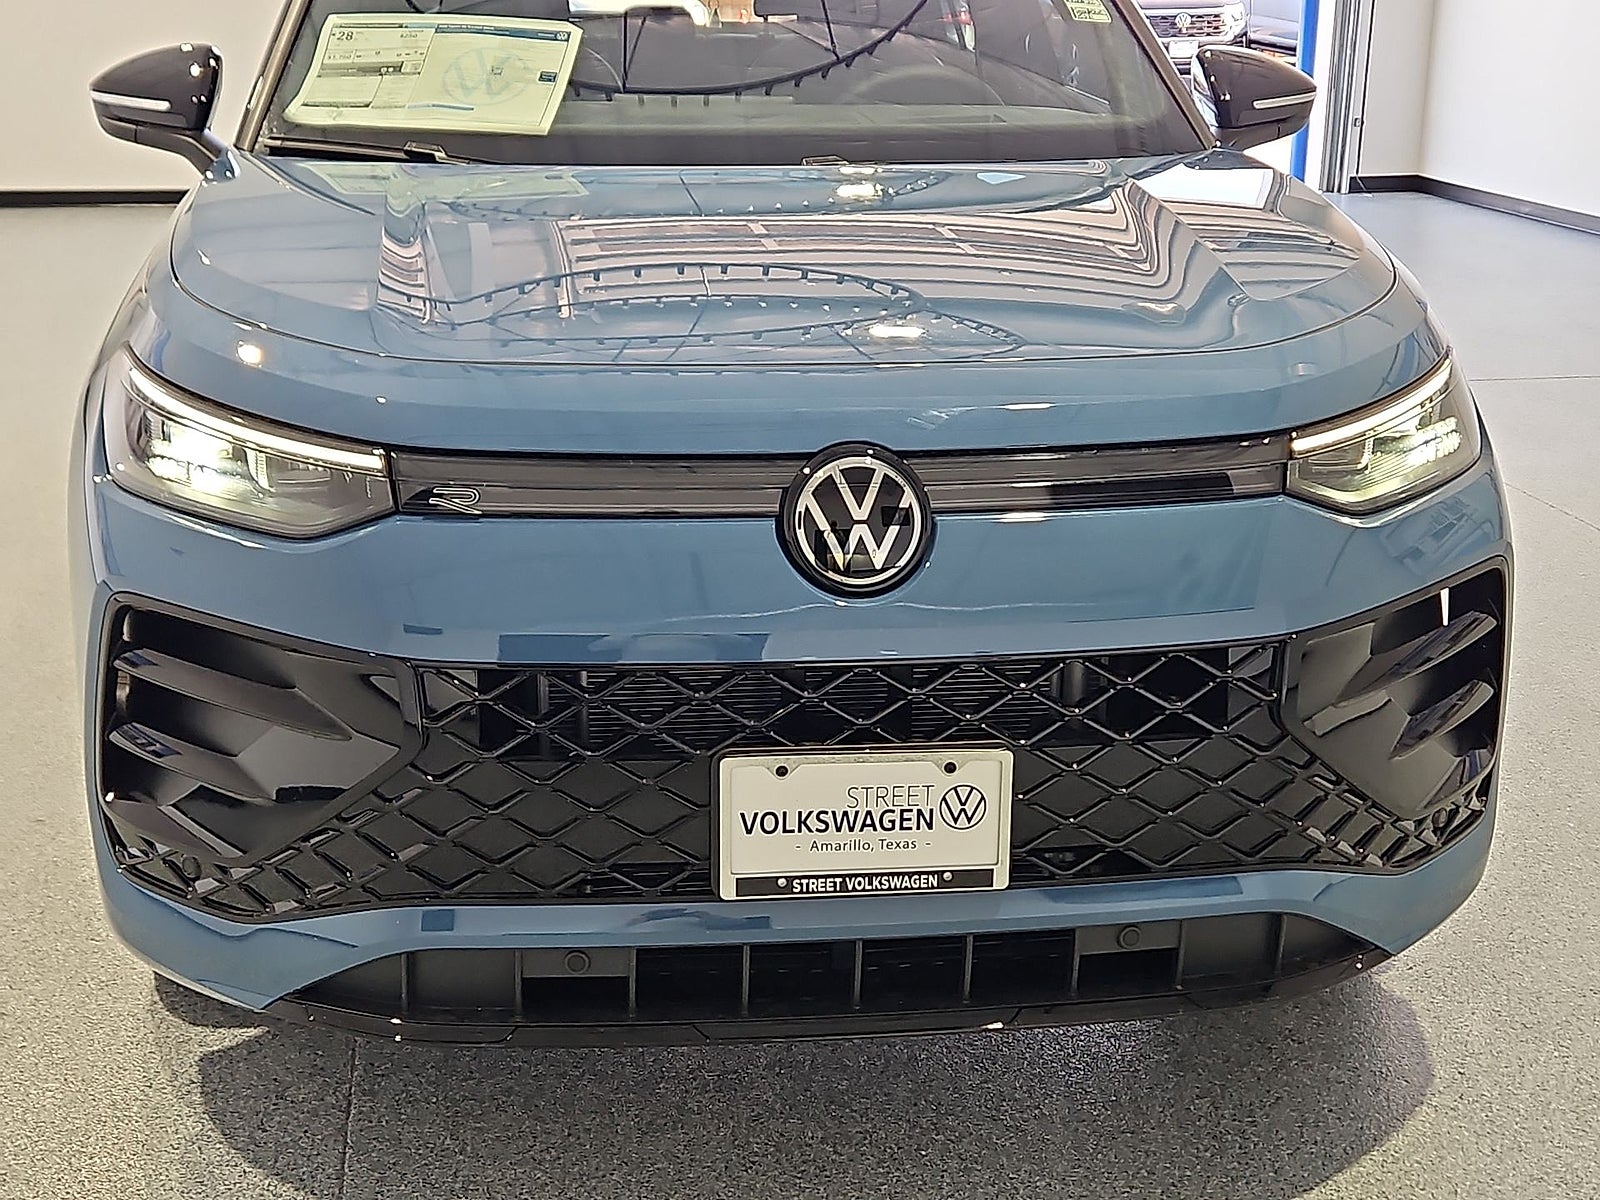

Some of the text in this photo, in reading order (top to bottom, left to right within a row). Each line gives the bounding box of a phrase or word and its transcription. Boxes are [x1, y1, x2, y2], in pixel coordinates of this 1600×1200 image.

[336, 31, 354, 41] 28
[429, 486, 482, 514] R
[797, 458, 920, 578] VW
[846, 784, 935, 809] STREET
[940, 784, 987, 830] VW
[740, 808, 934, 835] VOLKSWAGEN
[809, 840, 875, 853] Amarillo,
[879, 838, 917, 850] Texas
[793, 873, 938, 893] STREET VOLKSWAGEN
